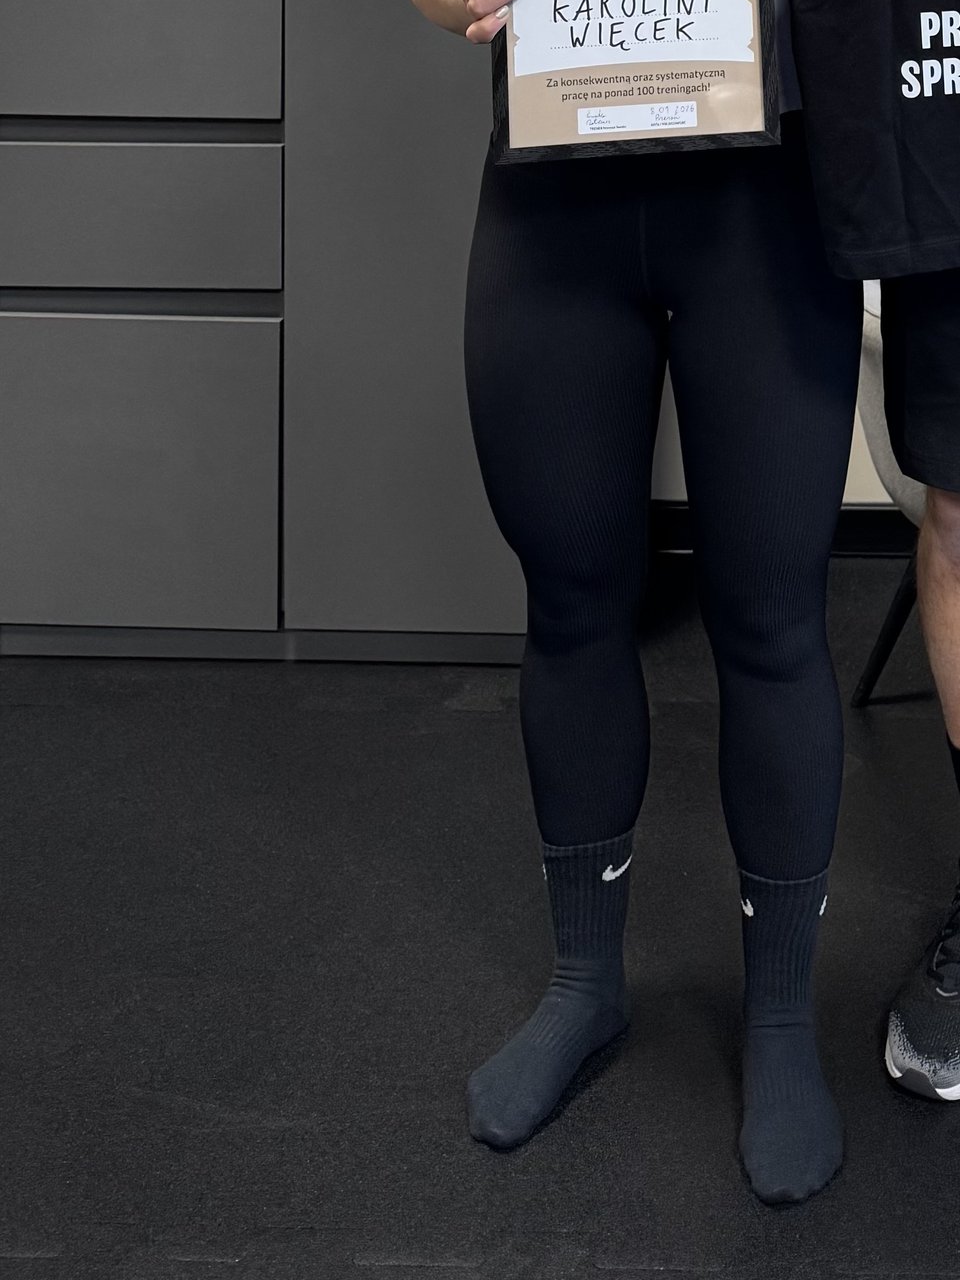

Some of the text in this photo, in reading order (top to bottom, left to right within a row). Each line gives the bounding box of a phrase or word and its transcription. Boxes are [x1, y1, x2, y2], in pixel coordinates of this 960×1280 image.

[570, 18, 695, 51] WIĘCEK
[546, 68, 726, 88] Za konsekwentną oraz systematyczną
[561, 82, 711, 102] pracę na ponad 100 treningach!
